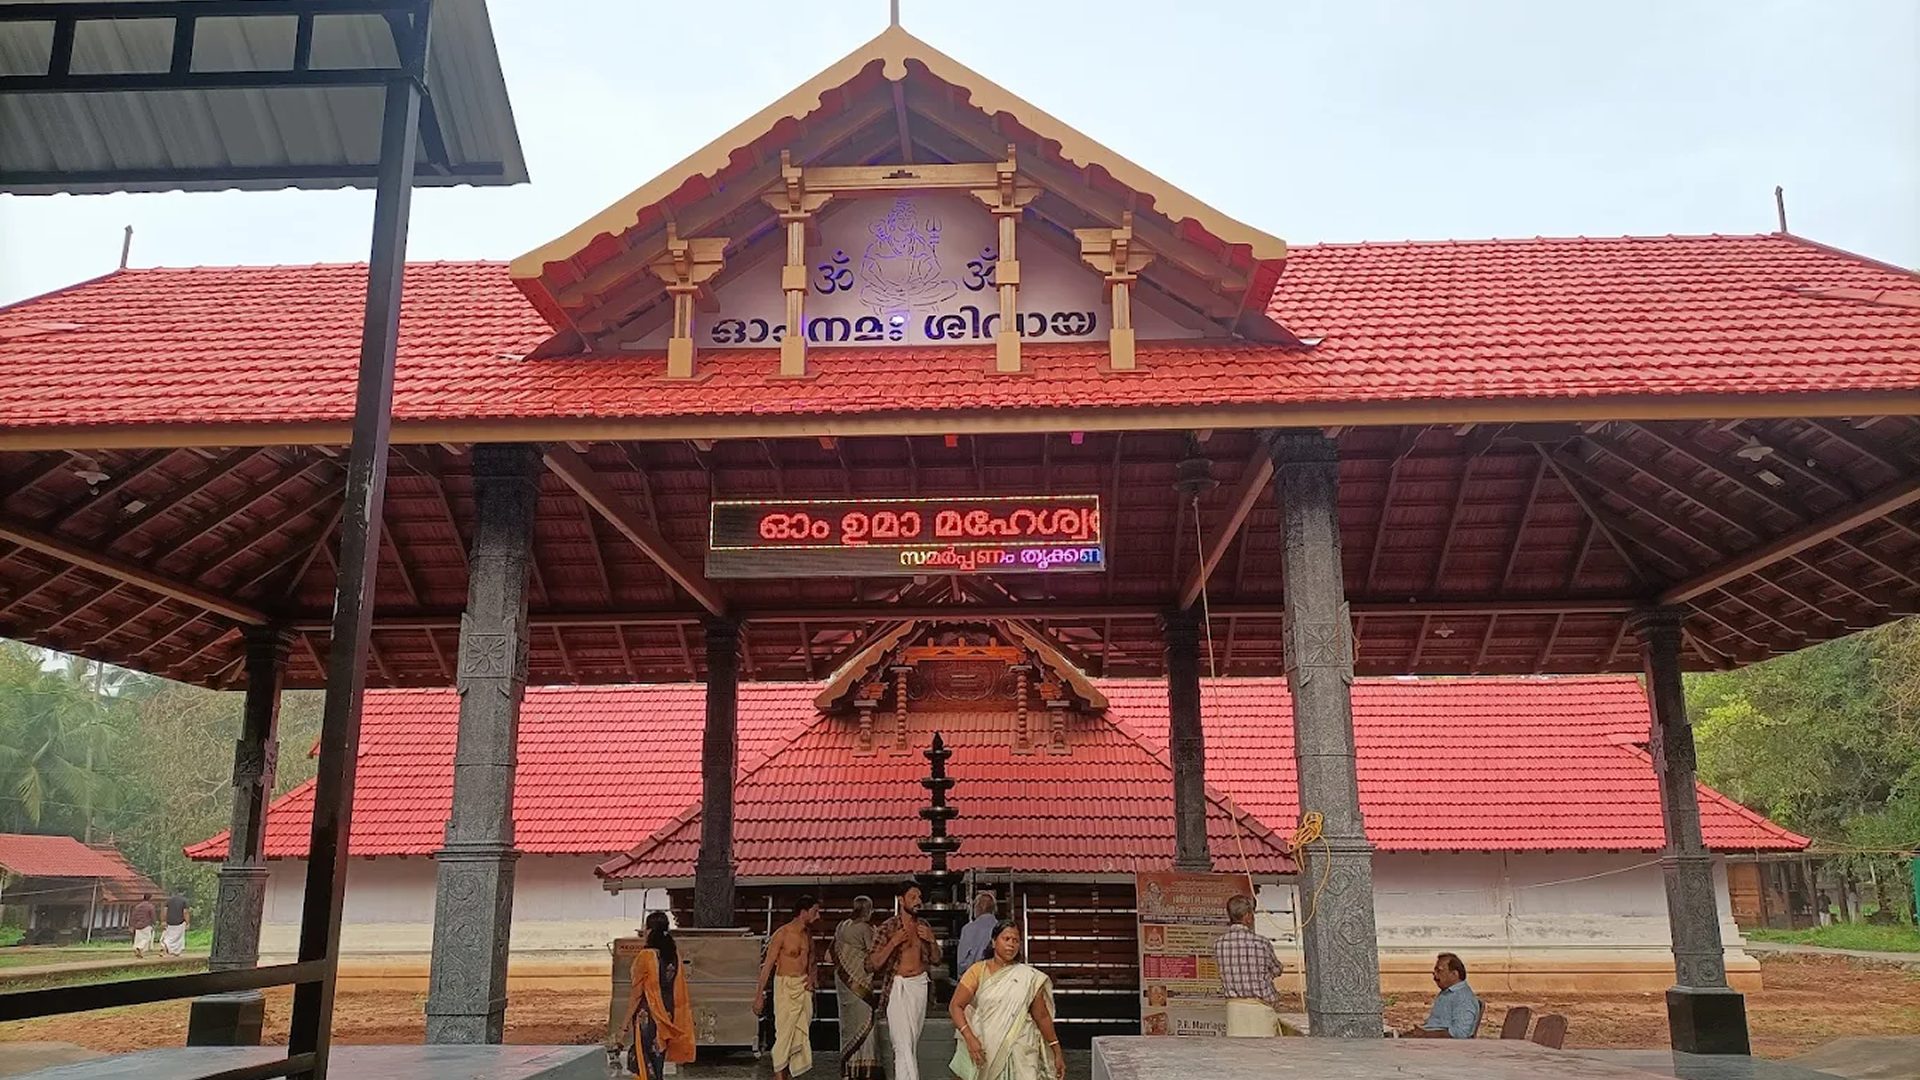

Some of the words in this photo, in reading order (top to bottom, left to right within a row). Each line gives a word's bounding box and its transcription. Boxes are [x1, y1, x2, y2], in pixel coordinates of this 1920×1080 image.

[760, 512, 830, 539] ഓം
[841, 511, 921, 545] ഉമാ
[900, 546, 1015, 571] സമർപ്പണം
